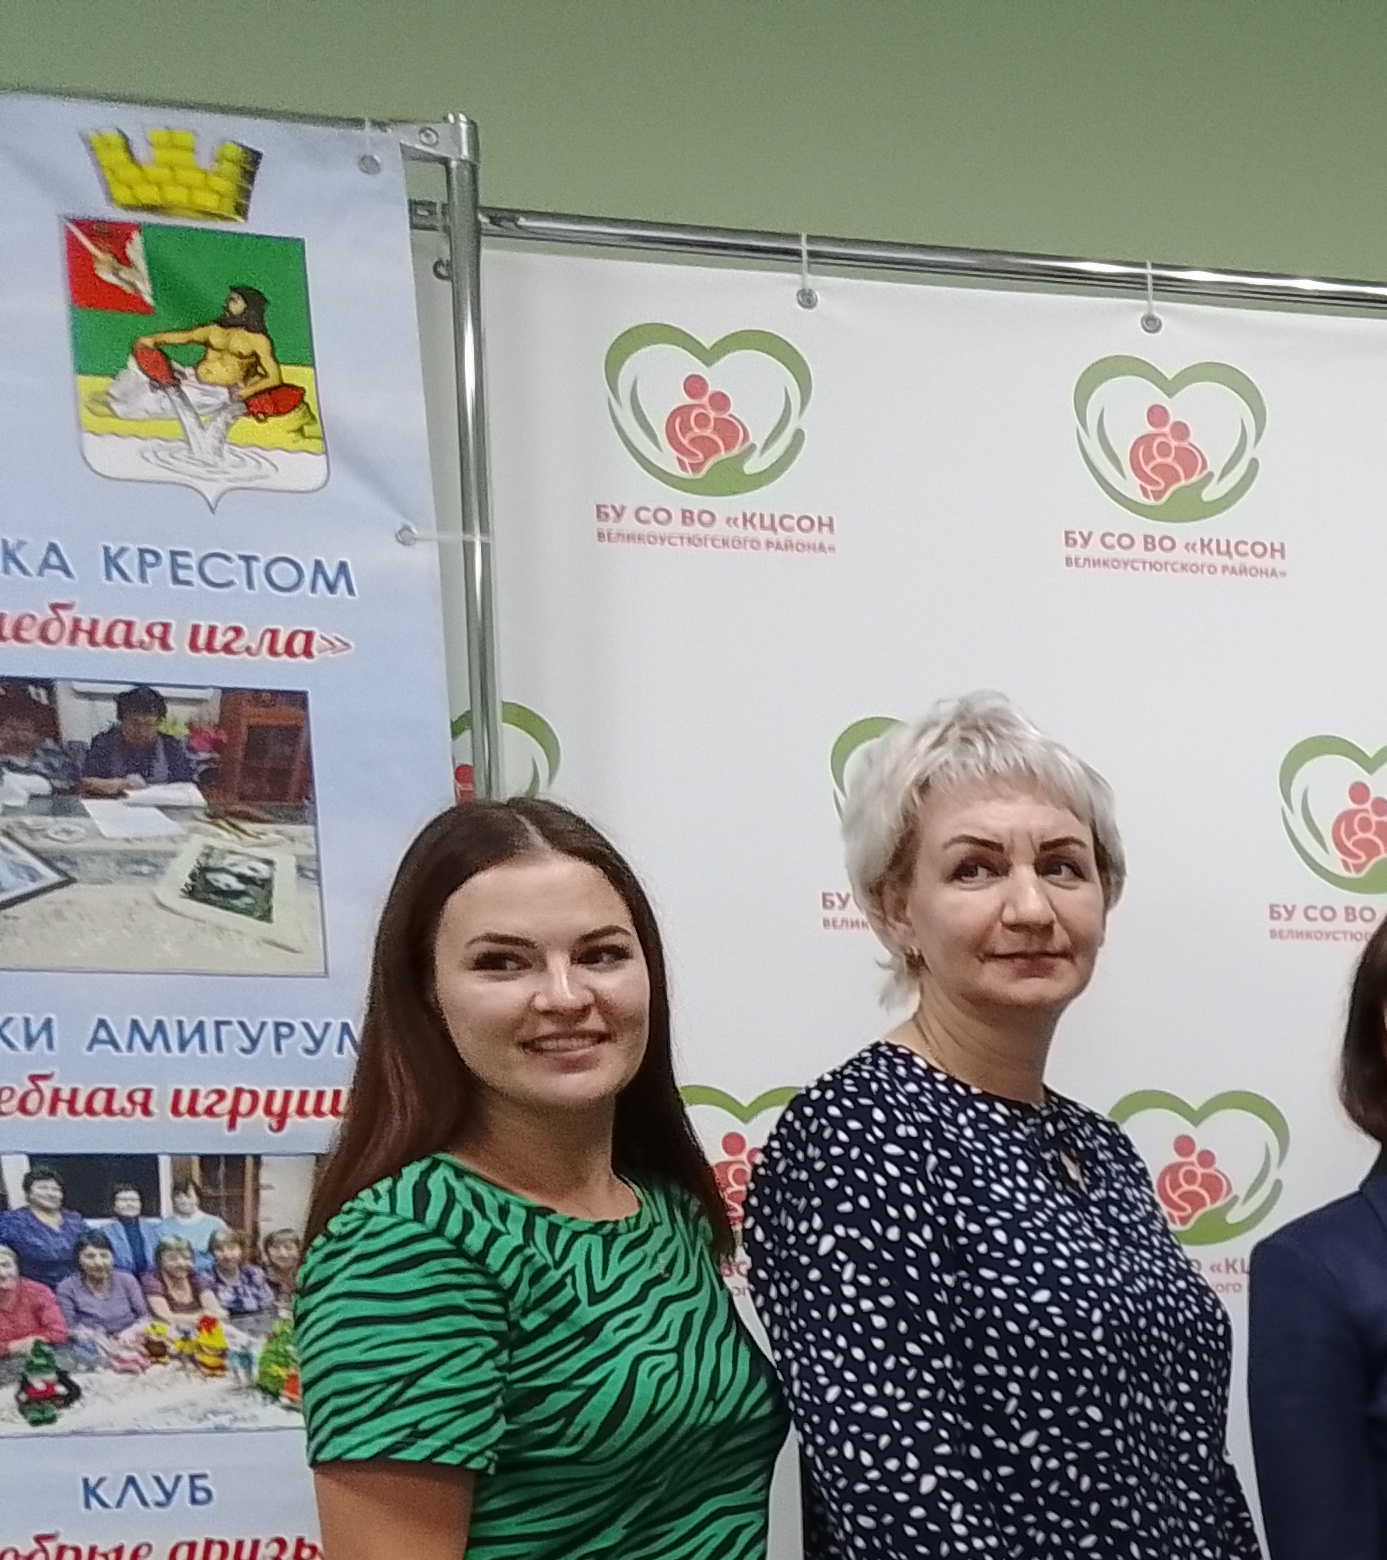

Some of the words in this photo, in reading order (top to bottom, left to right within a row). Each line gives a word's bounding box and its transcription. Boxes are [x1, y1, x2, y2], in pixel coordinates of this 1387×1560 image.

[596, 504, 626, 523] БУ
[635, 506, 672, 525] СО
[682, 508, 717, 528] ВО
[725, 510, 835, 535] «КЦСОН
[1064, 530, 1093, 549] БУ
[1100, 532, 1135, 550] СО
[1143, 534, 1176, 553] ВО
[1184, 537, 1286, 560] «КЦСОН
[103, 545, 356, 597] КРЕСТОМ
[1065, 556, 1218, 576] ВЕЛИКОУСТЮГСКОГО
[0, 602, 173, 651] ебная
[189, 622, 353, 659] игла»
[1269, 903, 1296, 921] БУ
[1303, 905, 1337, 922] СО
[1344, 906, 1376, 922] ВО
[82, 1474, 214, 1510] КЛУБ
